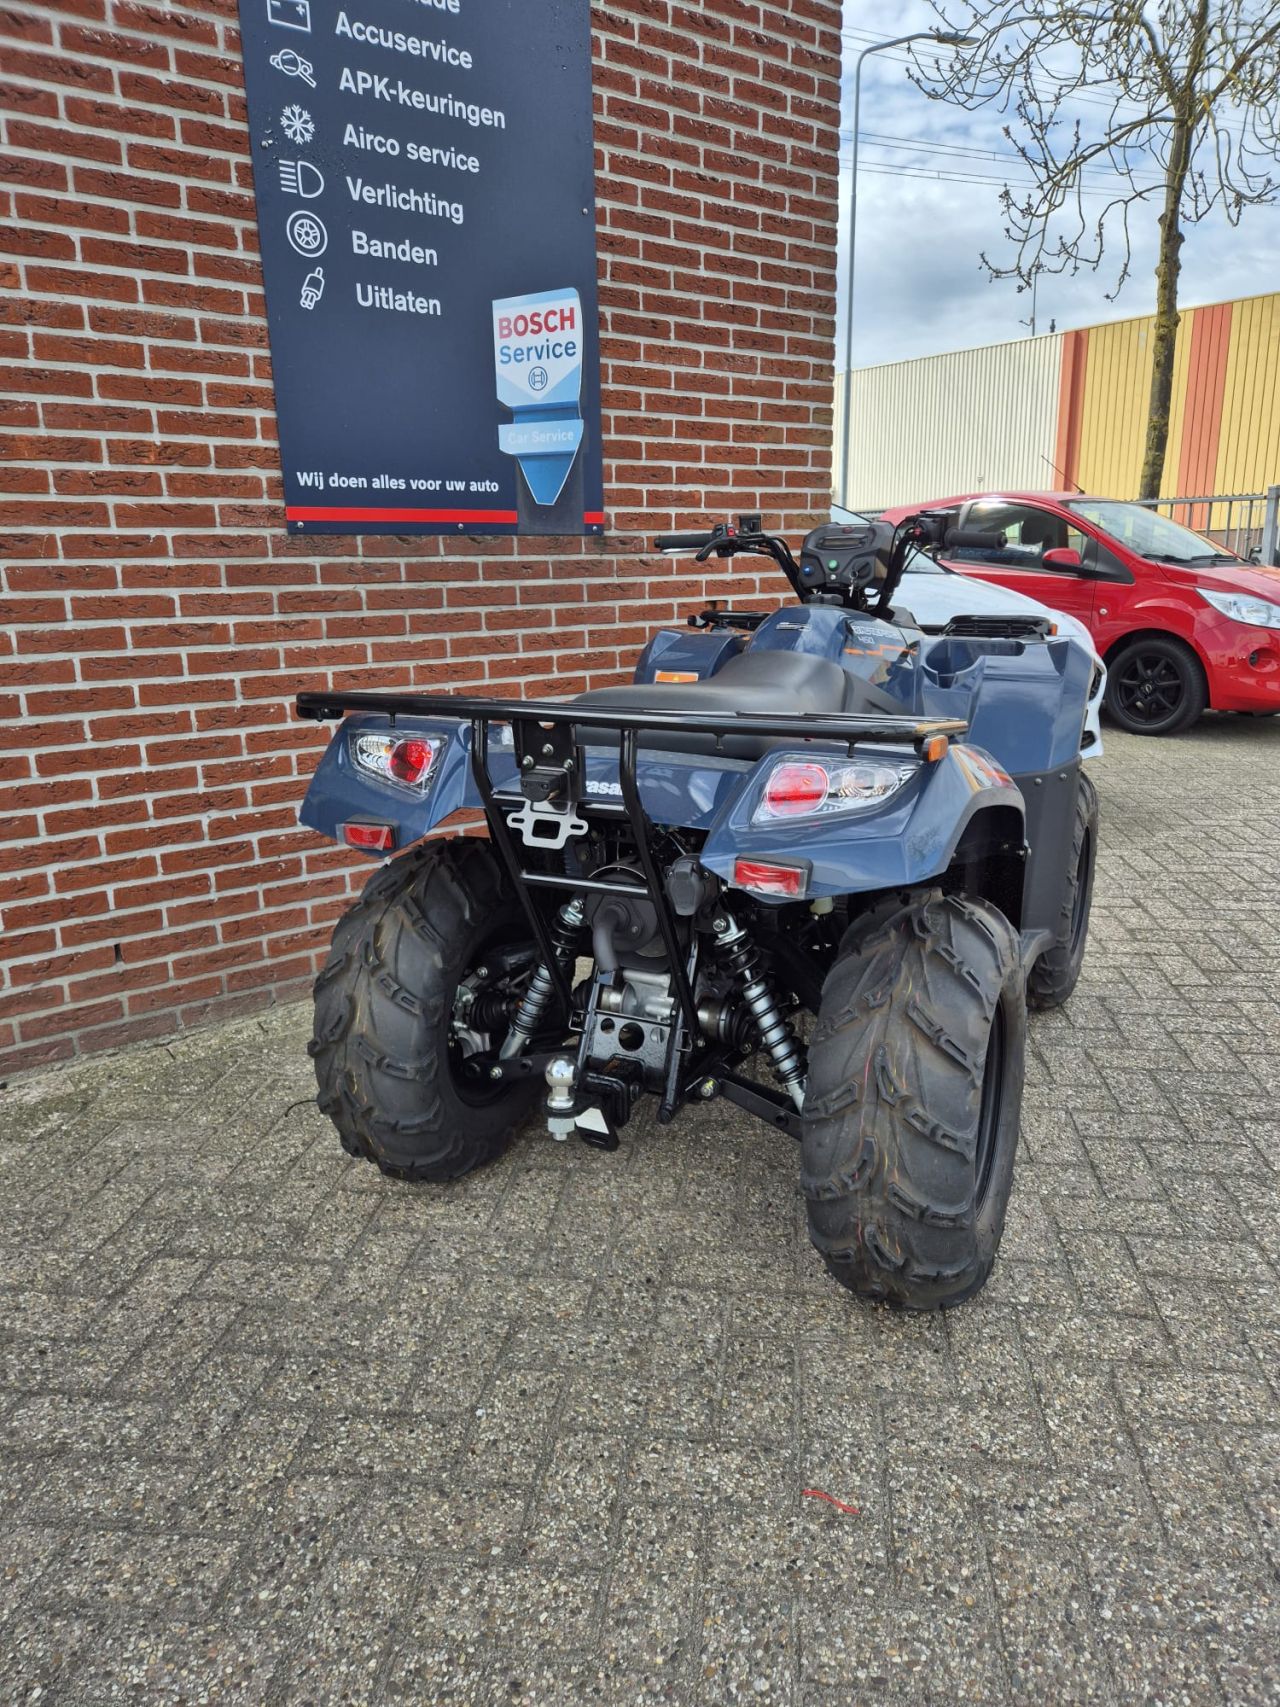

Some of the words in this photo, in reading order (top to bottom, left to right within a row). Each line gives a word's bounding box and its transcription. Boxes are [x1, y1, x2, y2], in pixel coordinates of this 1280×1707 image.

[335, 11, 473, 69] Accuservice
[339, 67, 506, 129] APK-keuringen
[343, 123, 400, 156] Airco
[406, 139, 480, 173] service
[346, 175, 465, 225] Verlichting
[352, 229, 438, 266] Banden
[355, 282, 442, 316] Uitlaten
[498, 307, 575, 339] BOSCH
[499, 338, 577, 365] Service
[508, 431, 529, 445] Car
[532, 428, 574, 444] Service
[296, 471, 324, 490] Wij
[328, 472, 368, 489] doen
[371, 474, 406, 490] alles
[409, 477, 442, 491] voor
[445, 479, 466, 491] uw
[469, 479, 500, 493] auto
